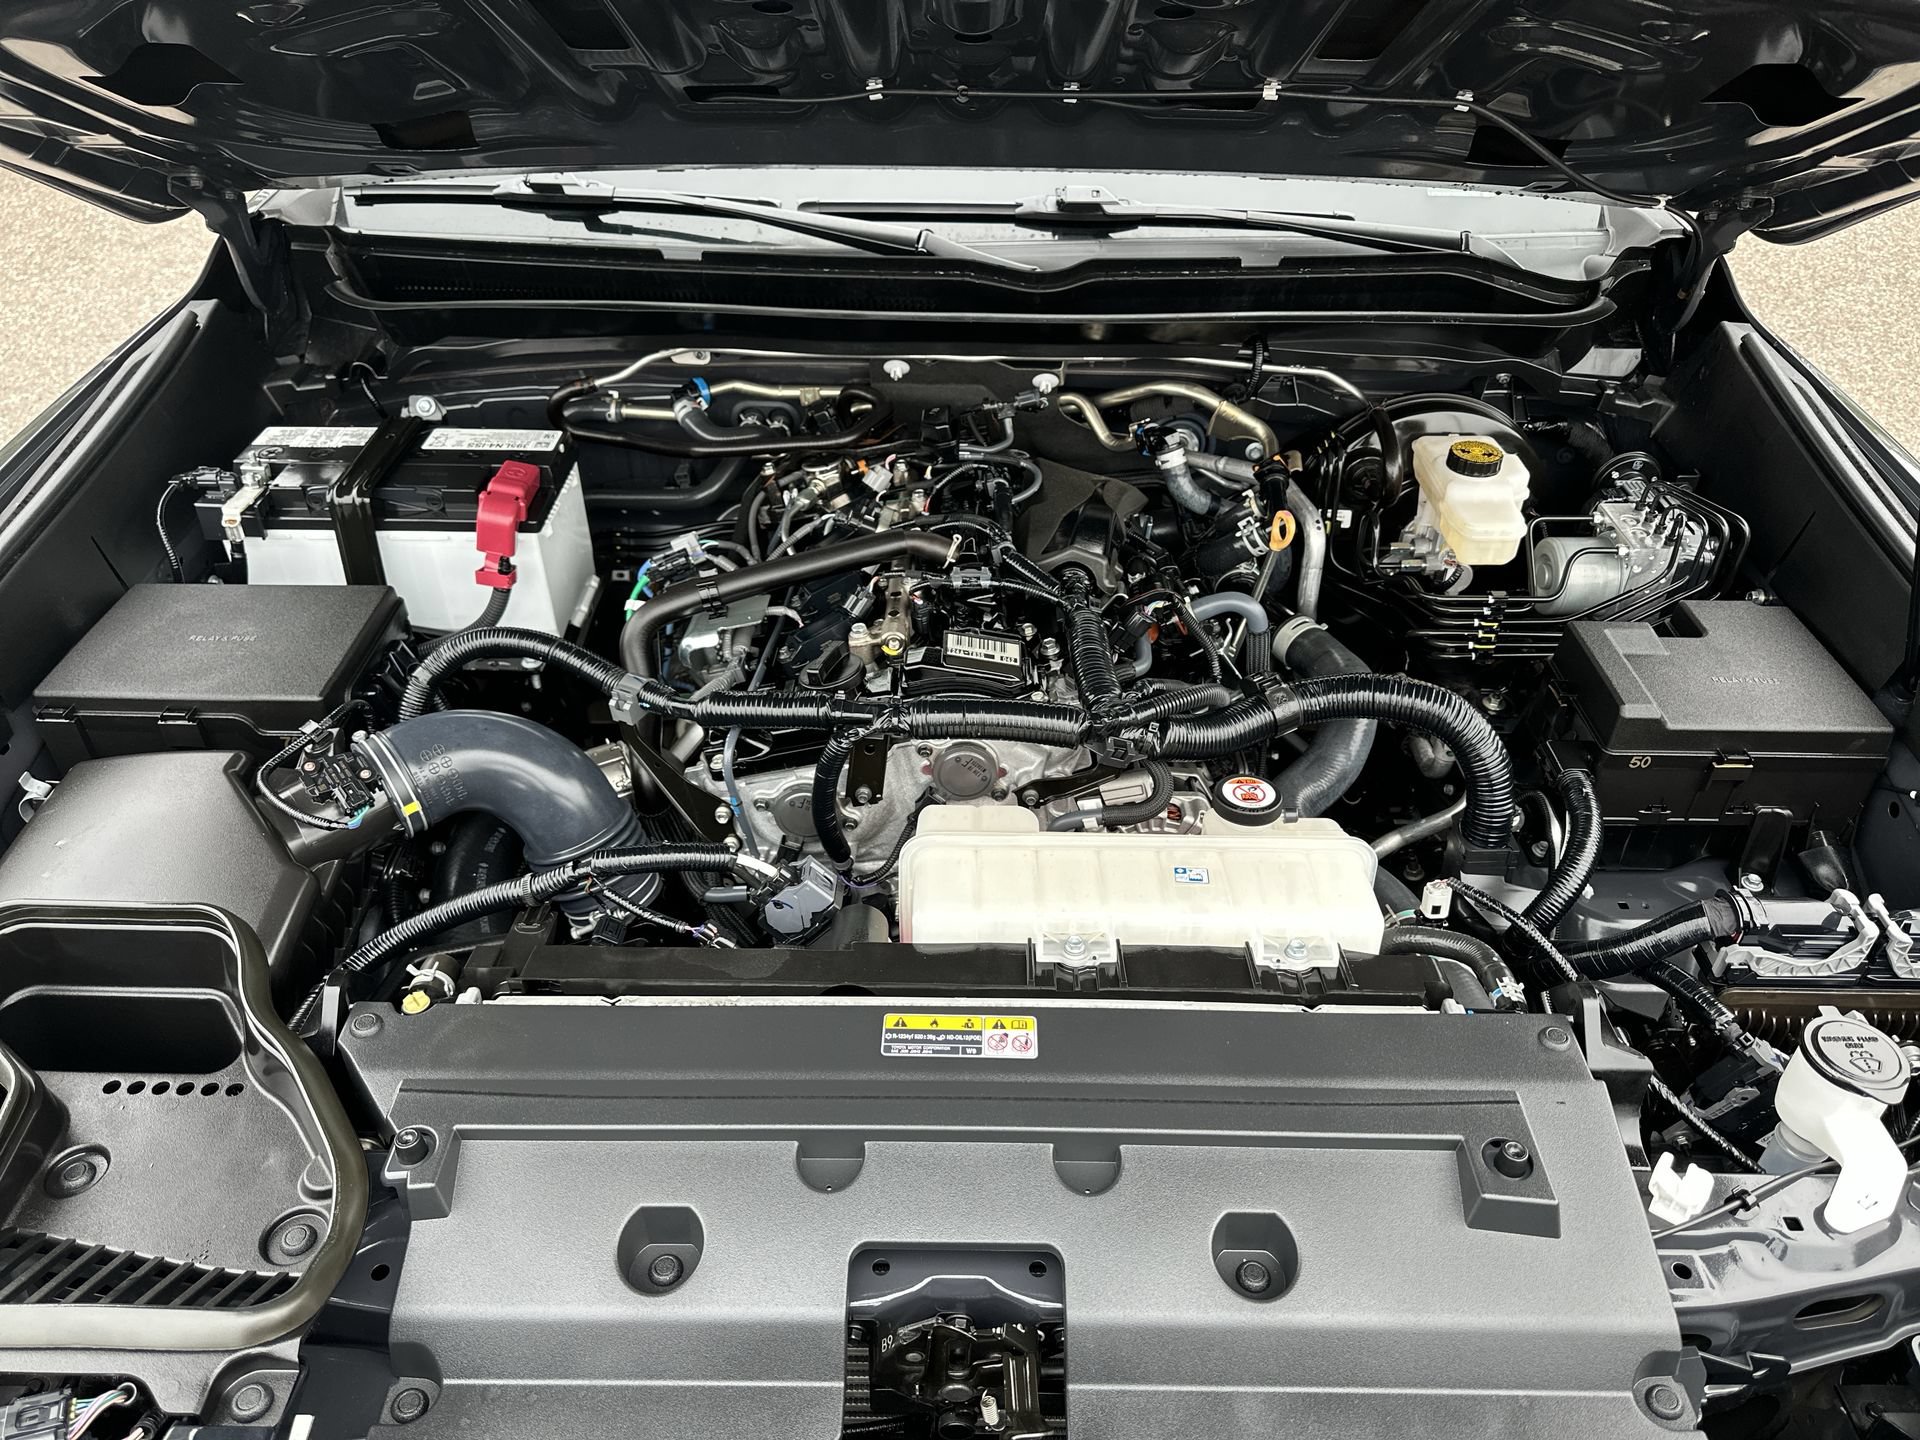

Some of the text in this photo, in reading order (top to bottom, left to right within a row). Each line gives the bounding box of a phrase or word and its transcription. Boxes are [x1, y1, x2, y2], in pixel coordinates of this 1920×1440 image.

[187, 634, 219, 642] RELAY
[1710, 675, 1743, 684] RELAY
[1628, 756, 1652, 769] 50
